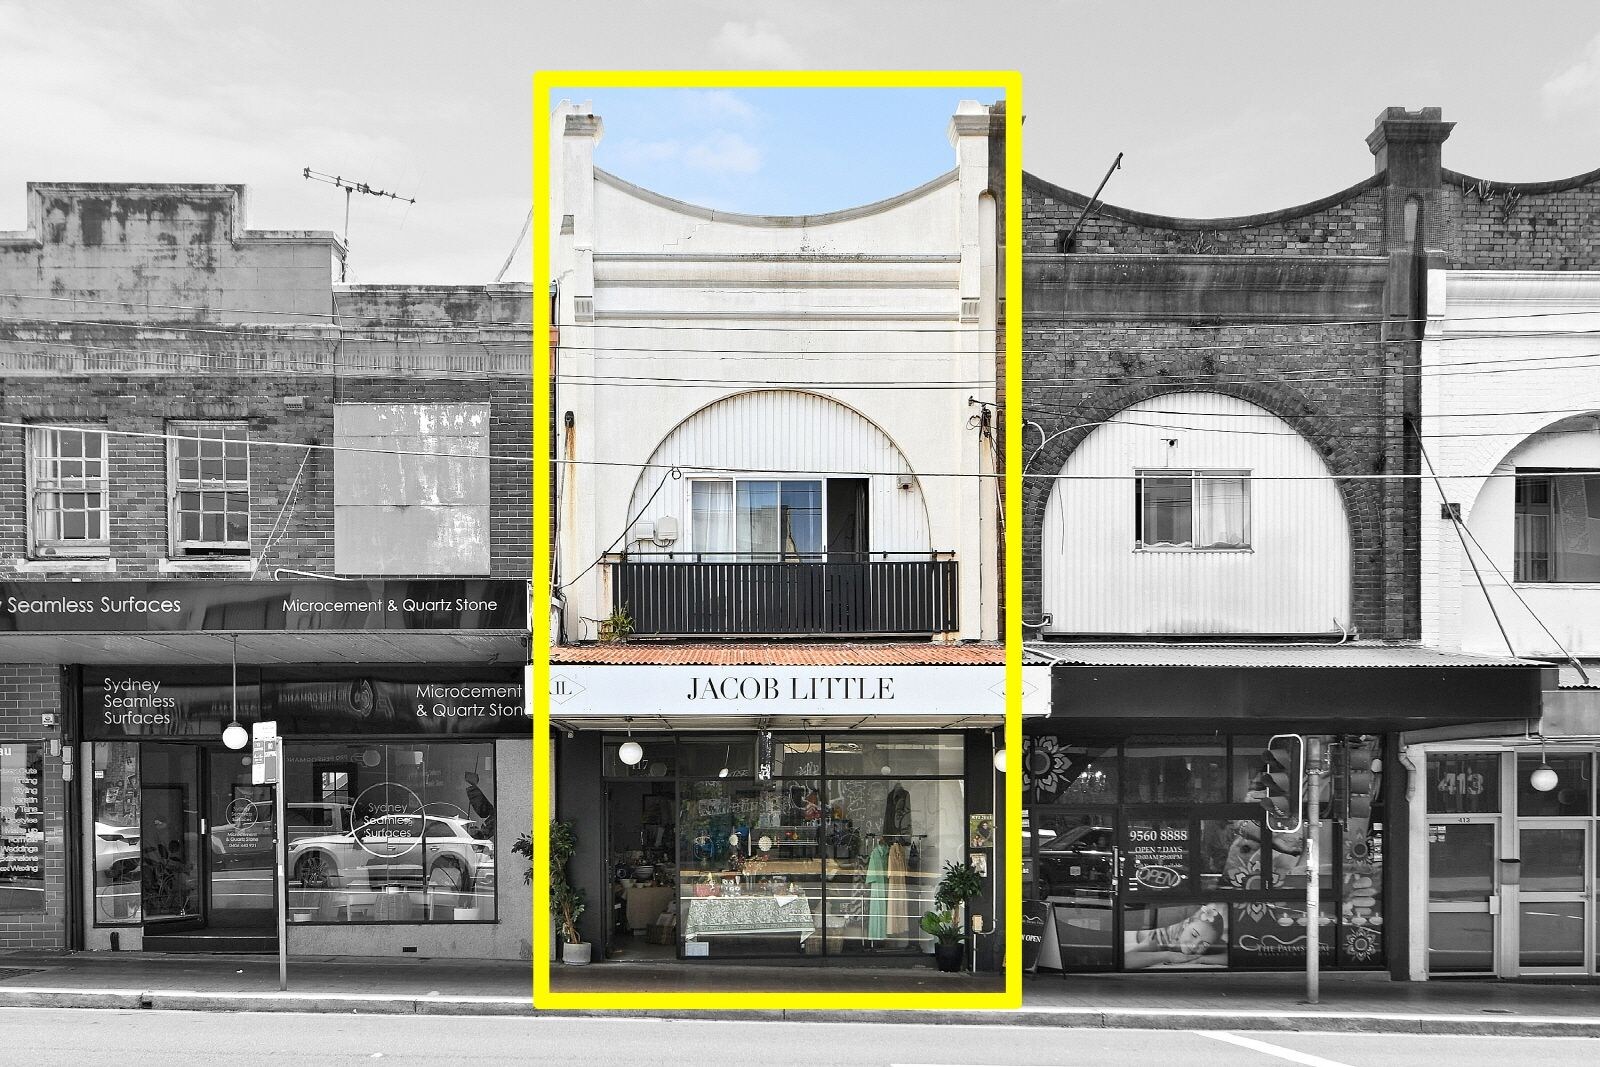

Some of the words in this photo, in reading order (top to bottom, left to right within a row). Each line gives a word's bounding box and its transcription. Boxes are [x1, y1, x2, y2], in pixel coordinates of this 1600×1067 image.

[7, 596, 94, 613] Seamless
[100, 595, 181, 613] Surfaces
[282, 599, 382, 612] Microcement
[387, 599, 399, 611] &
[402, 598, 452, 612] Quartz
[455, 598, 498, 611] Stone
[103, 677, 161, 694] Sydney
[416, 684, 523, 698] Microcement
[687, 676, 779, 700] JACOB
[789, 677, 895, 700] LITTLE
[104, 694, 175, 708] Seamless
[416, 704, 428, 717] &
[432, 703, 485, 717] Quartz
[489, 703, 523, 716] Ston
[104, 711, 171, 725] Surfaces
[1438, 773, 1484, 795] 413
[368, 803, 408, 815] Sydney
[363, 815, 413, 826] Seamless
[364, 827, 412, 838] Surfaces
[1130, 830, 1157, 841] 9560
[1160, 830, 1188, 841] 8888
[1138, 867, 1177, 885] OPEN
[1025, 934, 1042, 942] OPEN
